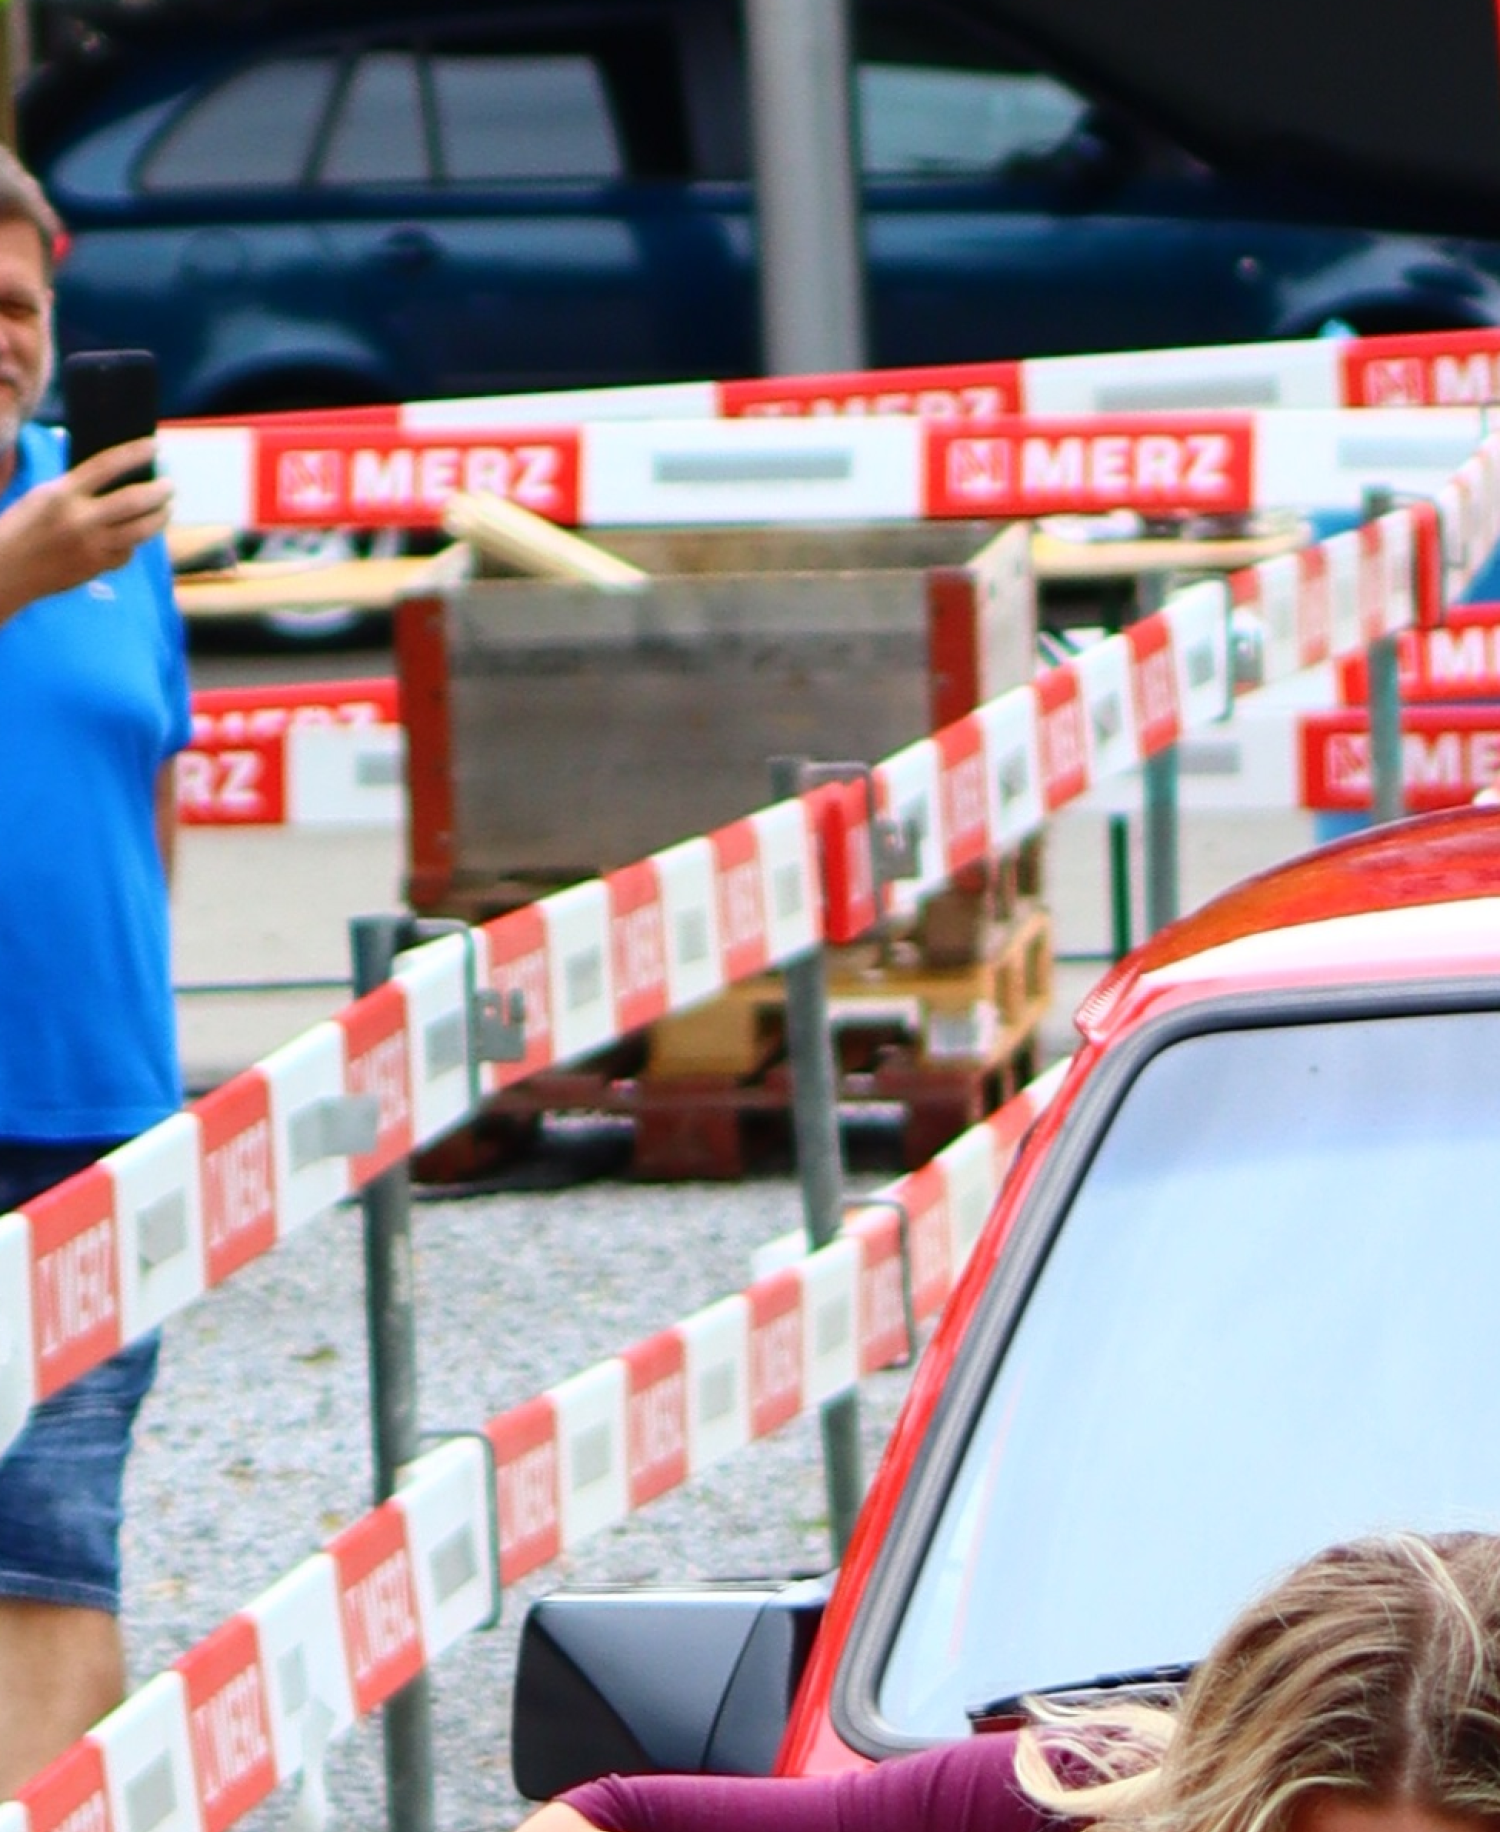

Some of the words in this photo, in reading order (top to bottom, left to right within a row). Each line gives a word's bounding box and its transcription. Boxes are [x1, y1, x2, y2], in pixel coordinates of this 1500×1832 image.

[350, 445, 560, 509] MERZ
[1022, 434, 1230, 494] MERZ
[175, 749, 260, 811] RZ
